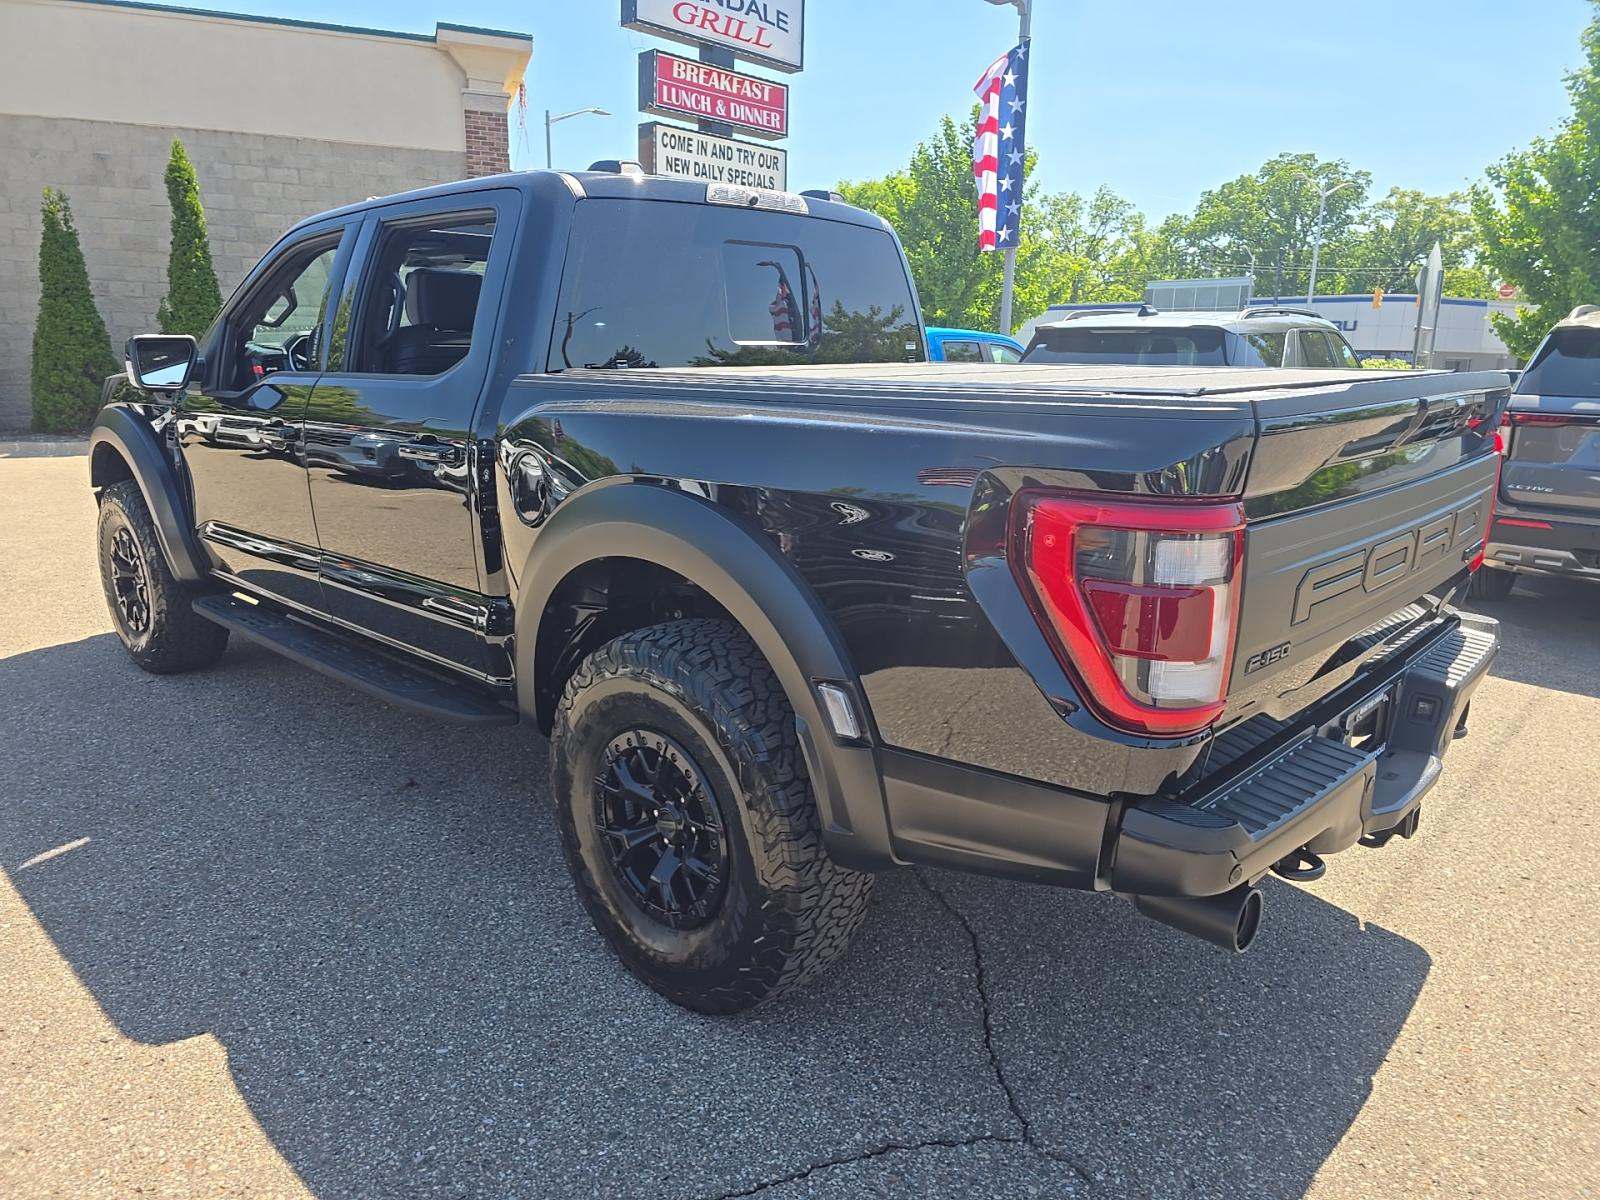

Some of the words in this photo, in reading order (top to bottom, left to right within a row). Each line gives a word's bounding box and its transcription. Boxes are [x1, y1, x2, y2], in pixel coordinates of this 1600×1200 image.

[672, 2, 773, 48] GRILL
[705, 0, 789, 33] DALE
[672, 60, 773, 102] BREAKFAST
[662, 84, 712, 113] LUNCH
[715, 99, 728, 117] &
[730, 102, 781, 129] DINNER
[661, 131, 693, 154] COME
[696, 139, 708, 157] IN
[711, 143, 733, 161] AND
[736, 147, 756, 166] TRY
[758, 152, 780, 171] OUR
[665, 156, 691, 175] NEW
[693, 162, 725, 181] DAILY
[727, 168, 775, 190] SPECIALS
[1290, 497, 1482, 627] FORD
